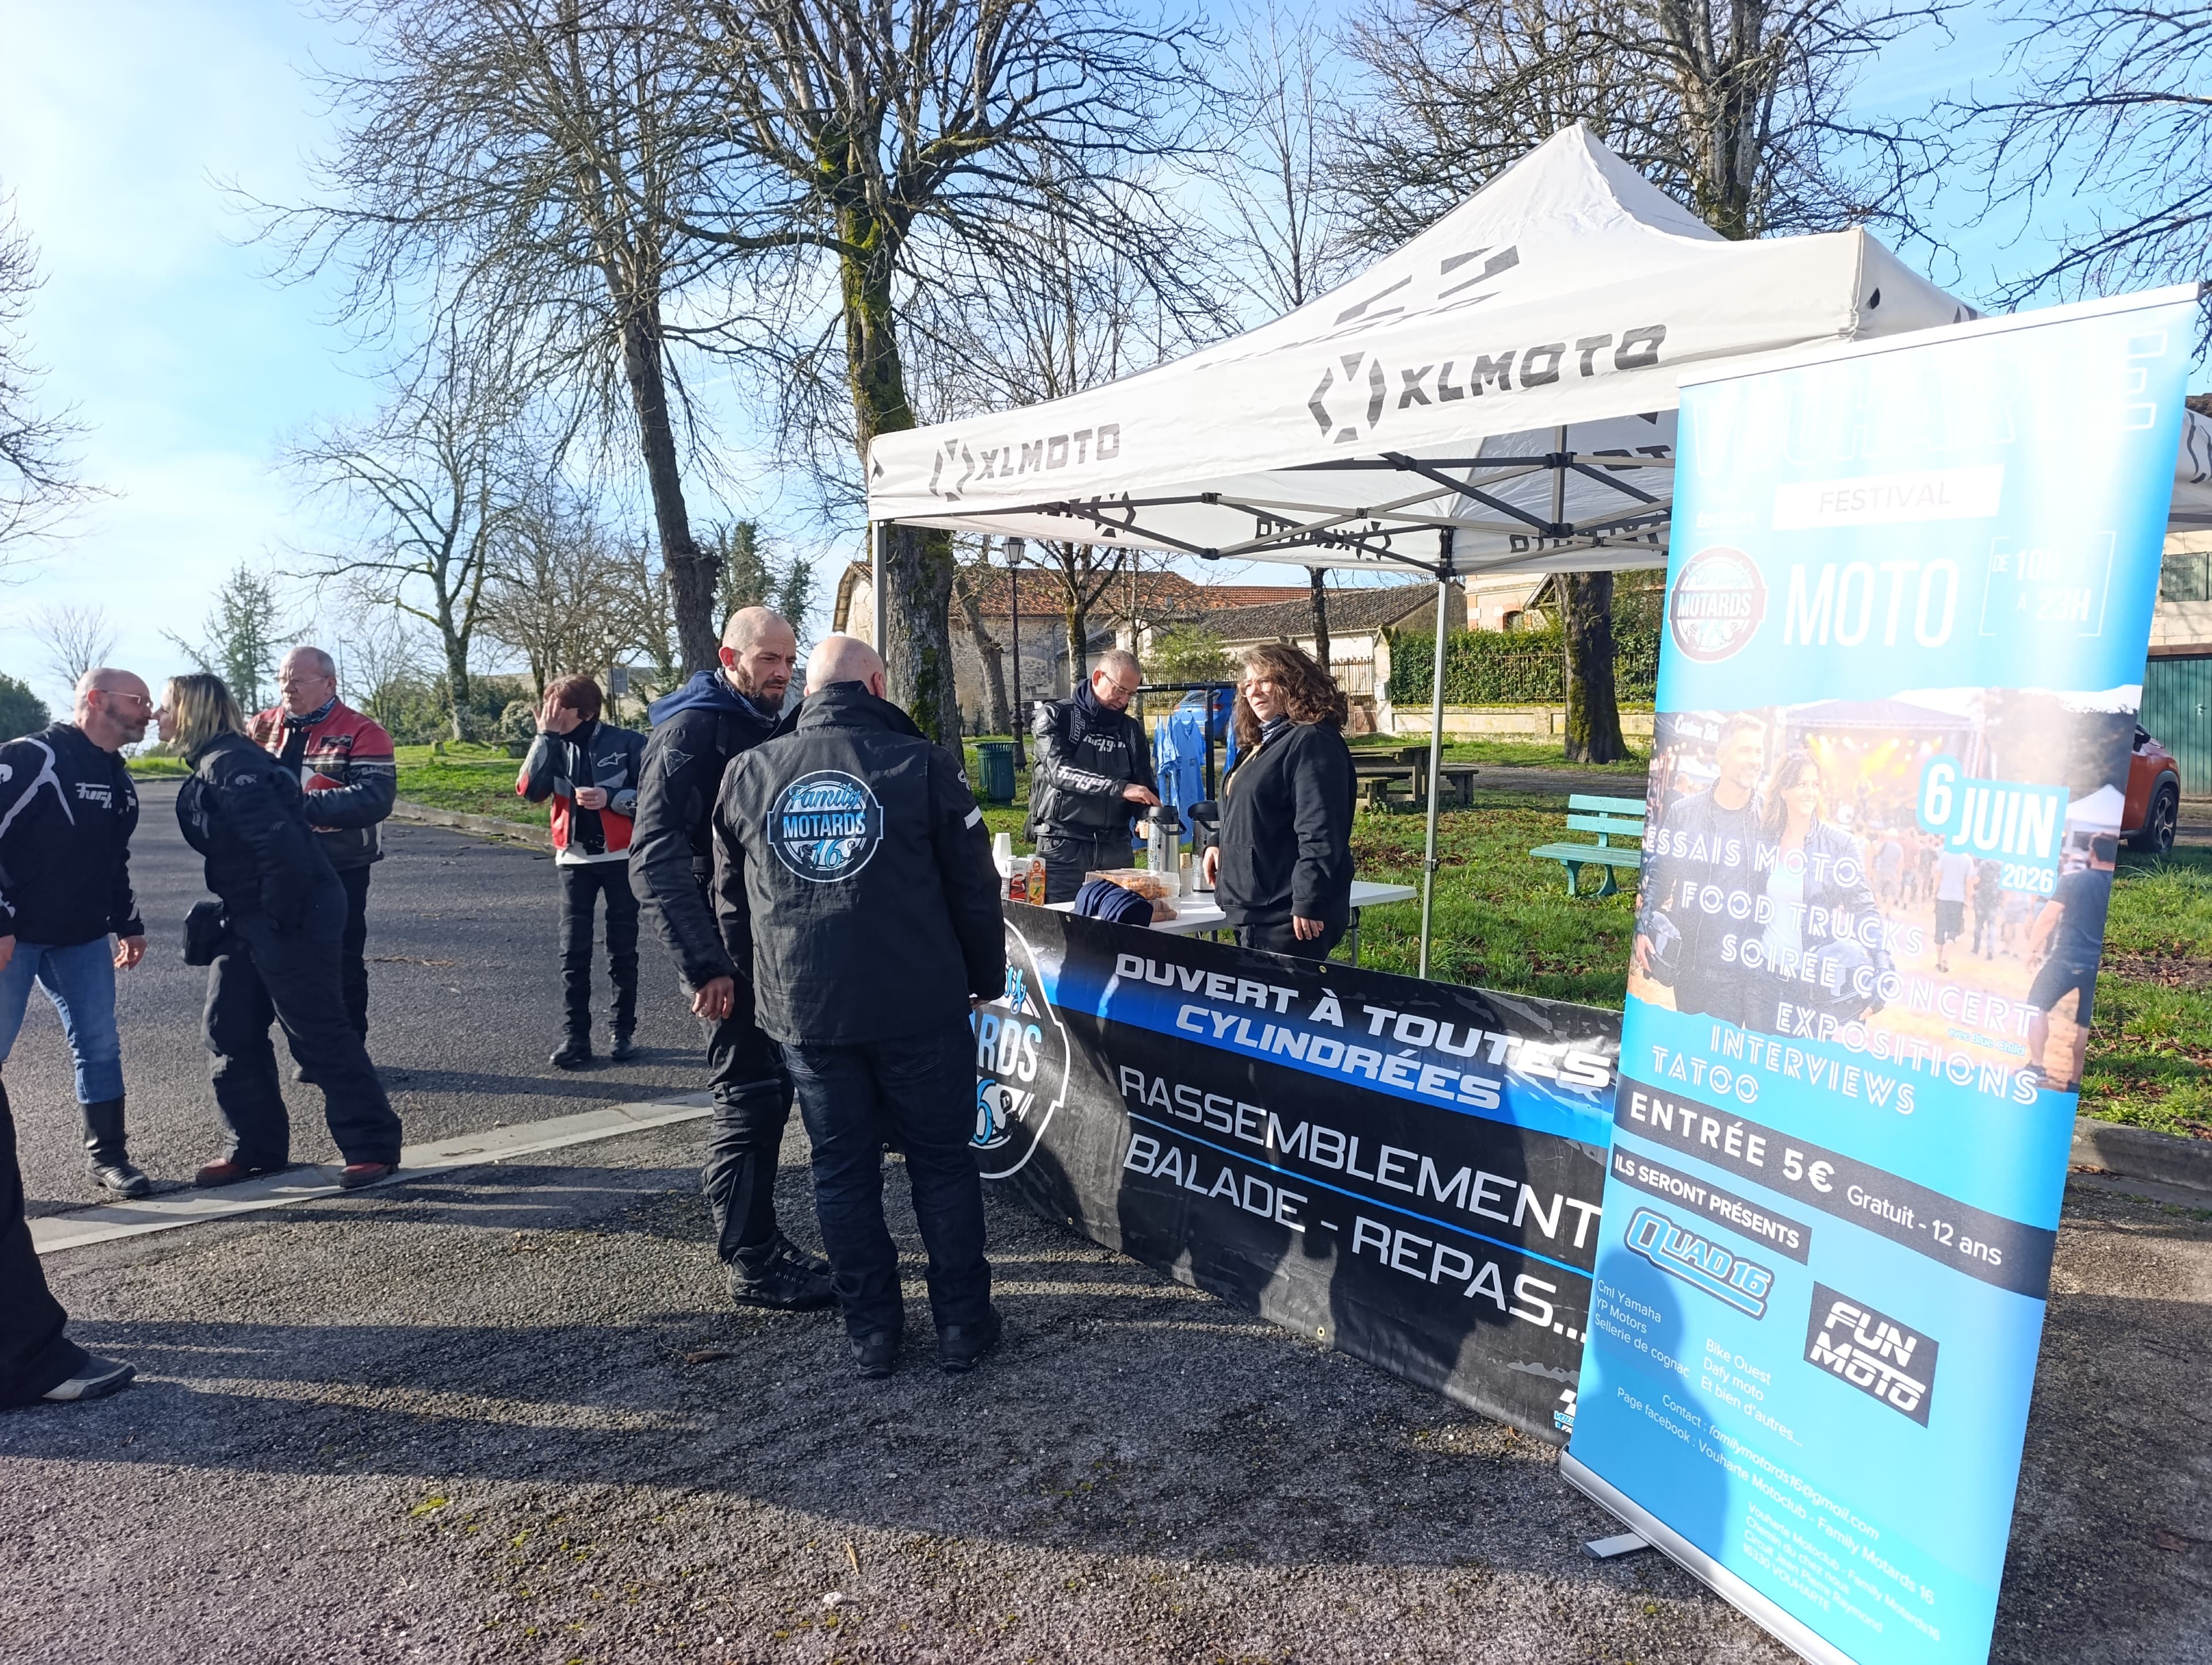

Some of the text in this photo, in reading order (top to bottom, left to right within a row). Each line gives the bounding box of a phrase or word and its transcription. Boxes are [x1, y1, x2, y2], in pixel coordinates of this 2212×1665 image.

[1397, 325, 1666, 409] XLMOTO
[975, 423, 1119, 480] XLMOTO
[1819, 481, 1952, 514] FESTIVAL
[1677, 592, 1752, 617] MOTARDS
[1782, 558, 1957, 647] MOTO
[783, 813, 866, 839] MOTARDS
[789, 783, 862, 810] Family
[1923, 763, 2058, 858] 6 JUIN
[812, 839, 846, 868] 16
[1645, 825, 1862, 888] ESSAIS MOTO
[2002, 863, 2055, 893] 2026
[1681, 881, 1925, 956] FOOD TRUCKS
[1721, 934, 2040, 1038] SOIRÉE CONCERT
[1115, 953, 1611, 1087] OUVERT À TOUTES
[1176, 1004, 1501, 1109] CYLINDRÉES
[1652, 1045, 1759, 1104] TATOO
[1710, 1025, 1915, 1115] INTERVIEWS
[1776, 1002, 2039, 1105] EXPOSITIONS
[1120, 1065, 1603, 1249] RASSEMBLEMENT
[1123, 1133, 1308, 1233] BALADE
[1630, 1091, 1767, 1167] ENTRÉE
[1782, 1148, 1835, 1193] 5€
[1847, 1185, 1915, 1230] Gratuit
[1932, 1220, 1952, 1246] 12
[1959, 1236, 2002, 1266] ans
[1615, 1153, 1800, 1249] ILS SERONT PRÉSENTS
[1596, 1295, 1647, 1334] YP Motors
[1618, 1290, 1661, 1323] Yamaha
[1824, 1301, 1917, 1367] FUN
[1594, 1313, 1690, 1378] Sellerie de cognac
[1706, 1338, 1771, 1386] Bike Ouest
[1810, 1331, 1926, 1411] MOTO
[1662, 1394, 1702, 1428] Contact
[1700, 1375, 1713, 1392] Et
[1715, 1384, 1741, 1409] bien
[1703, 1356, 1764, 1401] Dafy moto
[1617, 1386, 1643, 1410] Page
[1645, 1404, 1691, 1444] facebook
[1699, 1439, 1749, 1481] Vouharte
[1751, 1474, 1807, 1520] Motoclub
[1817, 1516, 1860, 1555] Family
[1862, 1545, 1916, 1593] Motards
[1919, 1584, 1935, 1606] 16
